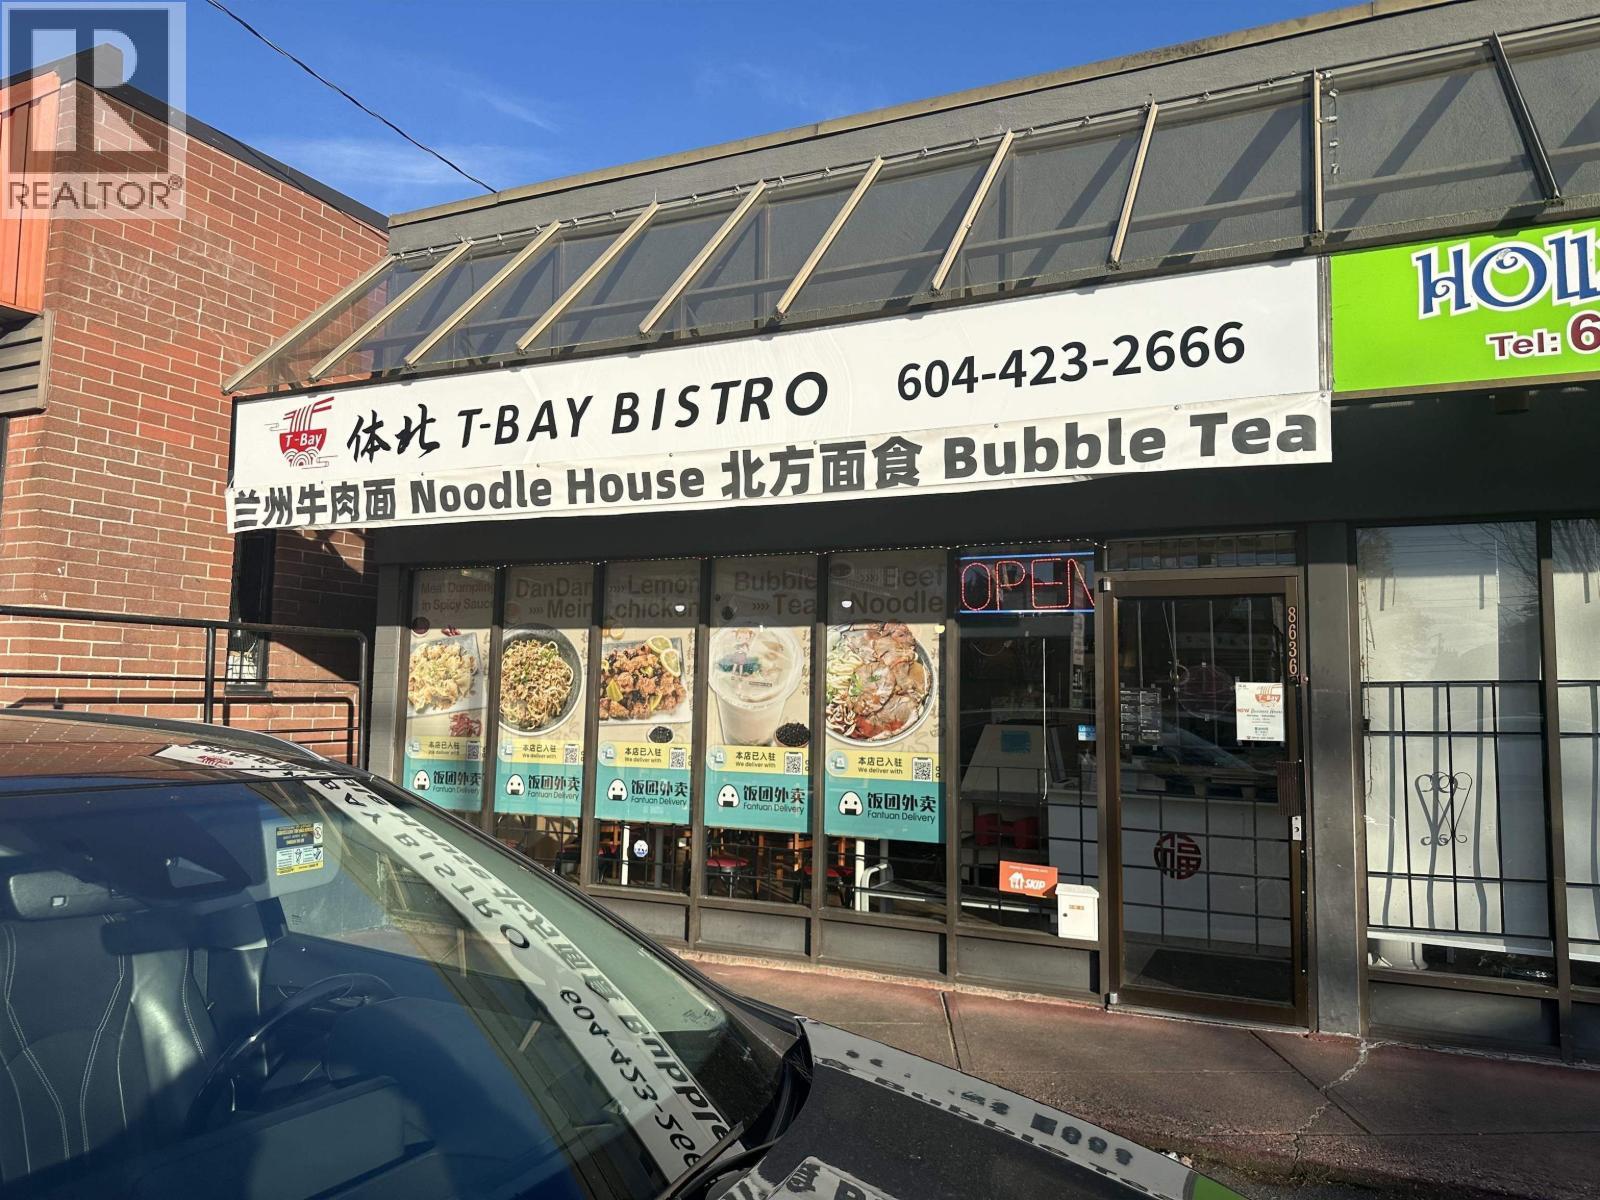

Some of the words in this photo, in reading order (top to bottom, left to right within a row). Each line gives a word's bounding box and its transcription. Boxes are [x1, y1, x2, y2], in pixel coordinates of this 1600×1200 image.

[1489, 332, 1557, 357] Tel:
[897, 321, 1246, 401] 604-423-2666
[456, 394, 595, 446] T-BAY
[611, 371, 829, 436] BISTRO
[284, 432, 324, 449] T-Bay
[233, 476, 397, 527] 兰州牛肉面
[410, 471, 552, 514] Noodle
[566, 461, 706, 504] House
[722, 435, 923, 500] 北方面食
[944, 417, 1166, 481] Bubble
[1189, 410, 1318, 458] Tea
[734, 566, 817, 591] Bubble
[960, 557, 1095, 612] OPEN
[433, 599, 462, 613] Spicy
[615, 598, 699, 618] chickn
[773, 592, 817, 615] Tea
[850, 589, 944, 614] Noodle
[1286, 606, 1298, 675] 8636
[735, 751, 776, 761] 本店已入驻
[858, 757, 903, 767] 本店已入驻
[528, 775, 580, 791] 饭团外卖
[631, 779, 688, 797] 饭团外卖
[527, 791, 553, 799] Fantuan
[553, 792, 579, 800] Delivery
[631, 796, 658, 804] Fantuan
[659, 797, 687, 806] Delivery
[743, 784, 806, 804] 饭团外卖
[867, 792, 936, 813] 饭团外卖
[743, 802, 773, 811] Fantuan
[774, 804, 804, 815] Delivery
[867, 810, 900, 820] Fantuan
[902, 812, 936, 824] Delivery
[1024, 878, 1046, 890] SKIP
